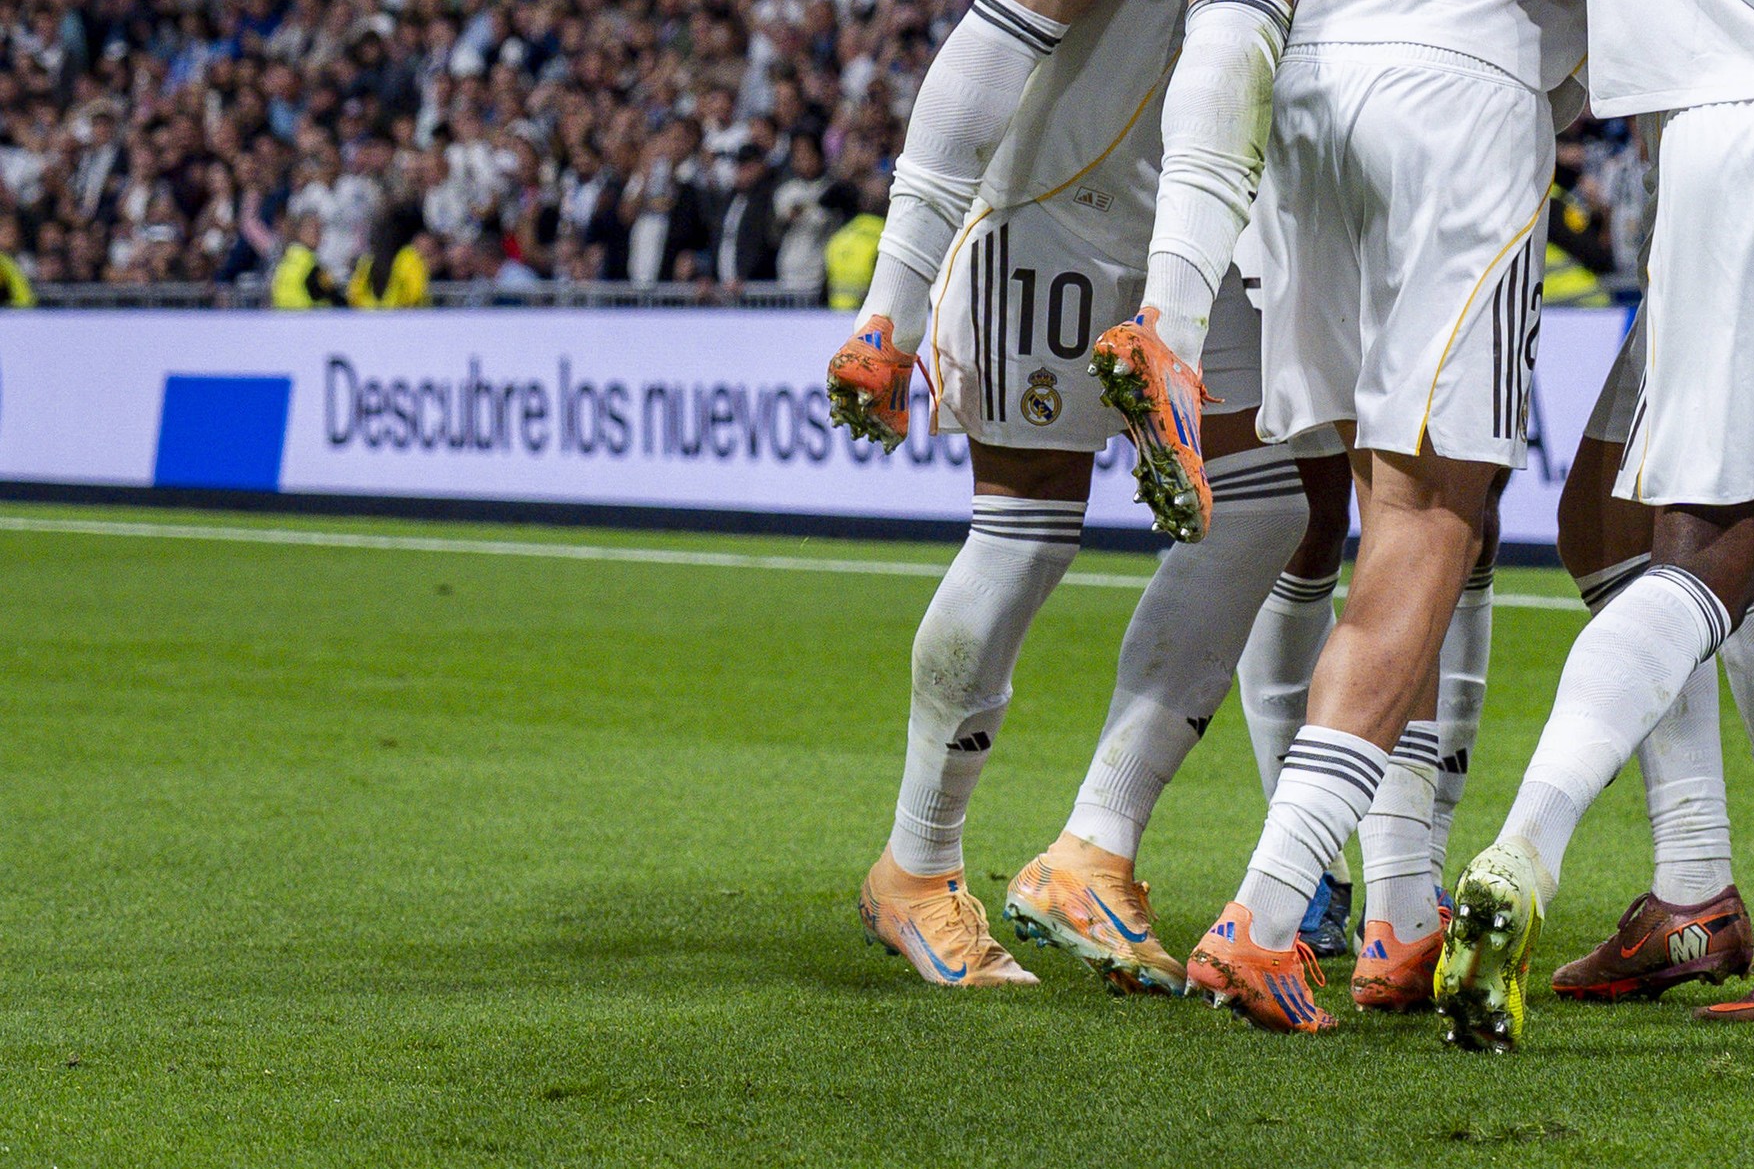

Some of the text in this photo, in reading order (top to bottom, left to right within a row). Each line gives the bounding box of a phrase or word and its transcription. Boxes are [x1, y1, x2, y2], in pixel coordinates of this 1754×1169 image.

[1010, 268, 1093, 360] 10
[324, 355, 553, 456] Descubre
[557, 357, 630, 461] los
[640, 379, 833, 466] nuevos
